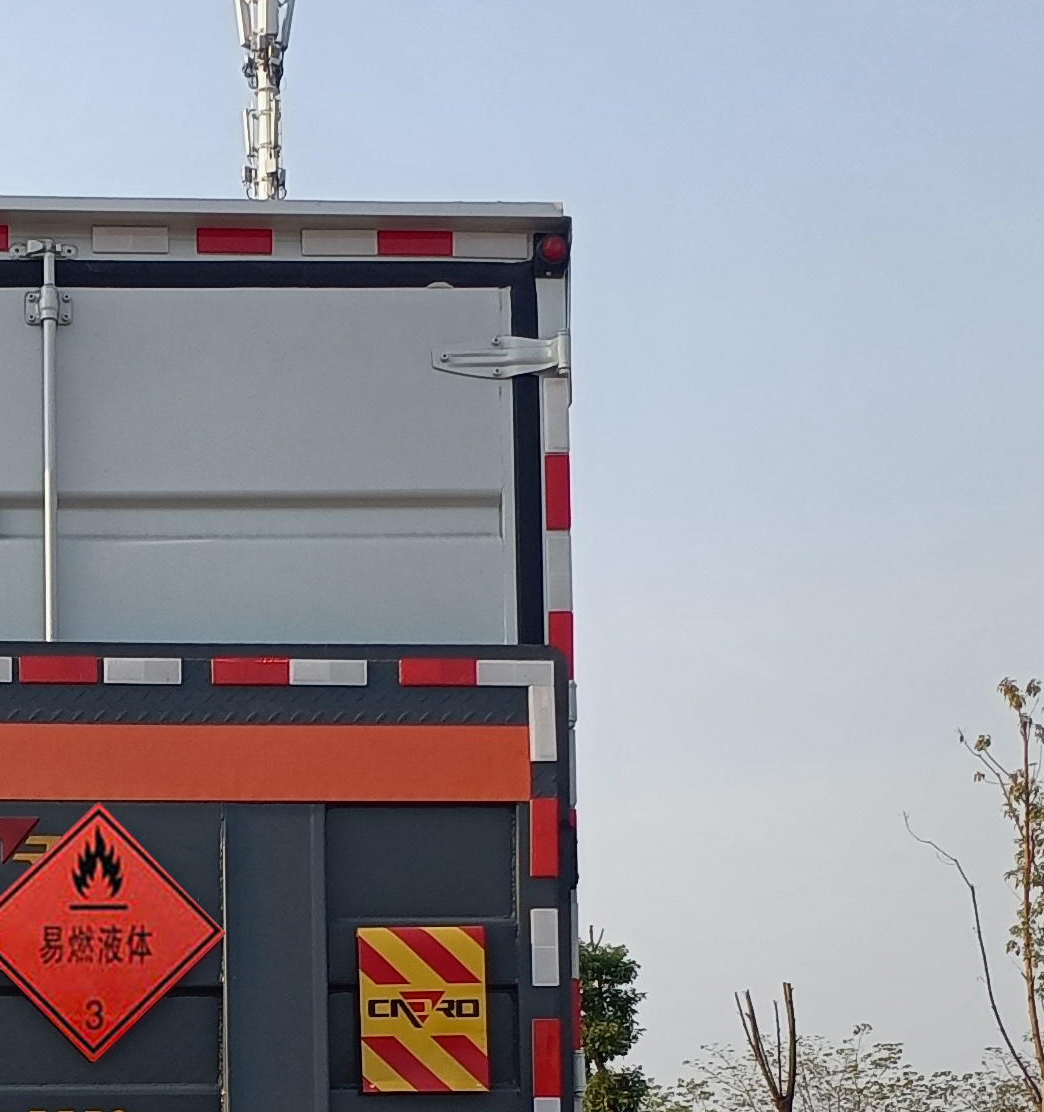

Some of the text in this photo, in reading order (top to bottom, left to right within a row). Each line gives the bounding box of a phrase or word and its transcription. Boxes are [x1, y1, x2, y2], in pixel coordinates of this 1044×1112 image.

[39, 925, 153, 965] 易燃液体
[85, 1000, 104, 1031] 3
